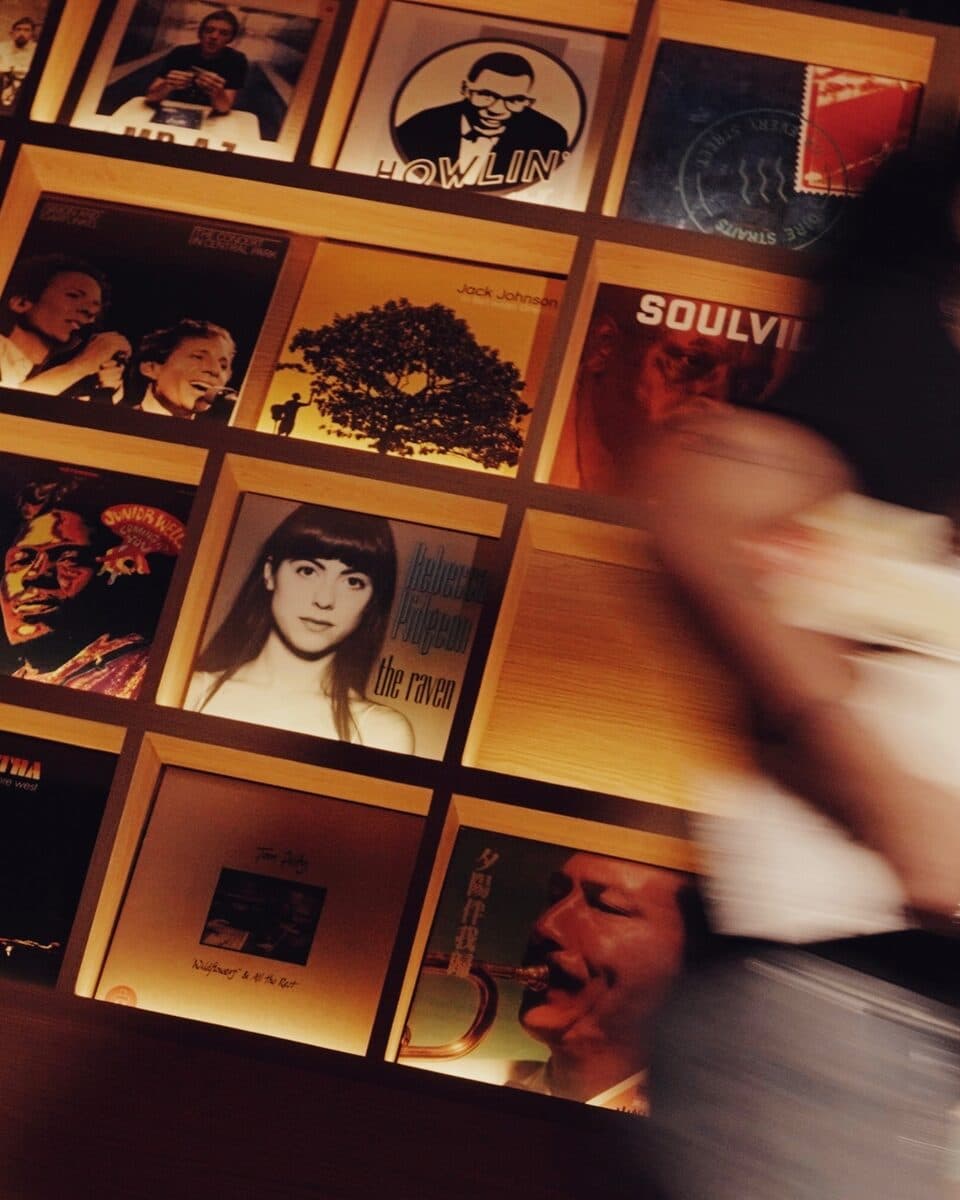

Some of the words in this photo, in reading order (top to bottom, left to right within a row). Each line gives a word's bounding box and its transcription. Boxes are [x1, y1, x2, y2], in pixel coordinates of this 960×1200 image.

[457, 284, 491, 298] Jack
[496, 290, 559, 309] Johnson
[104, 506, 154, 526] JUNIOR
[374, 655, 405, 700] the
[405, 672, 457, 711] raven
